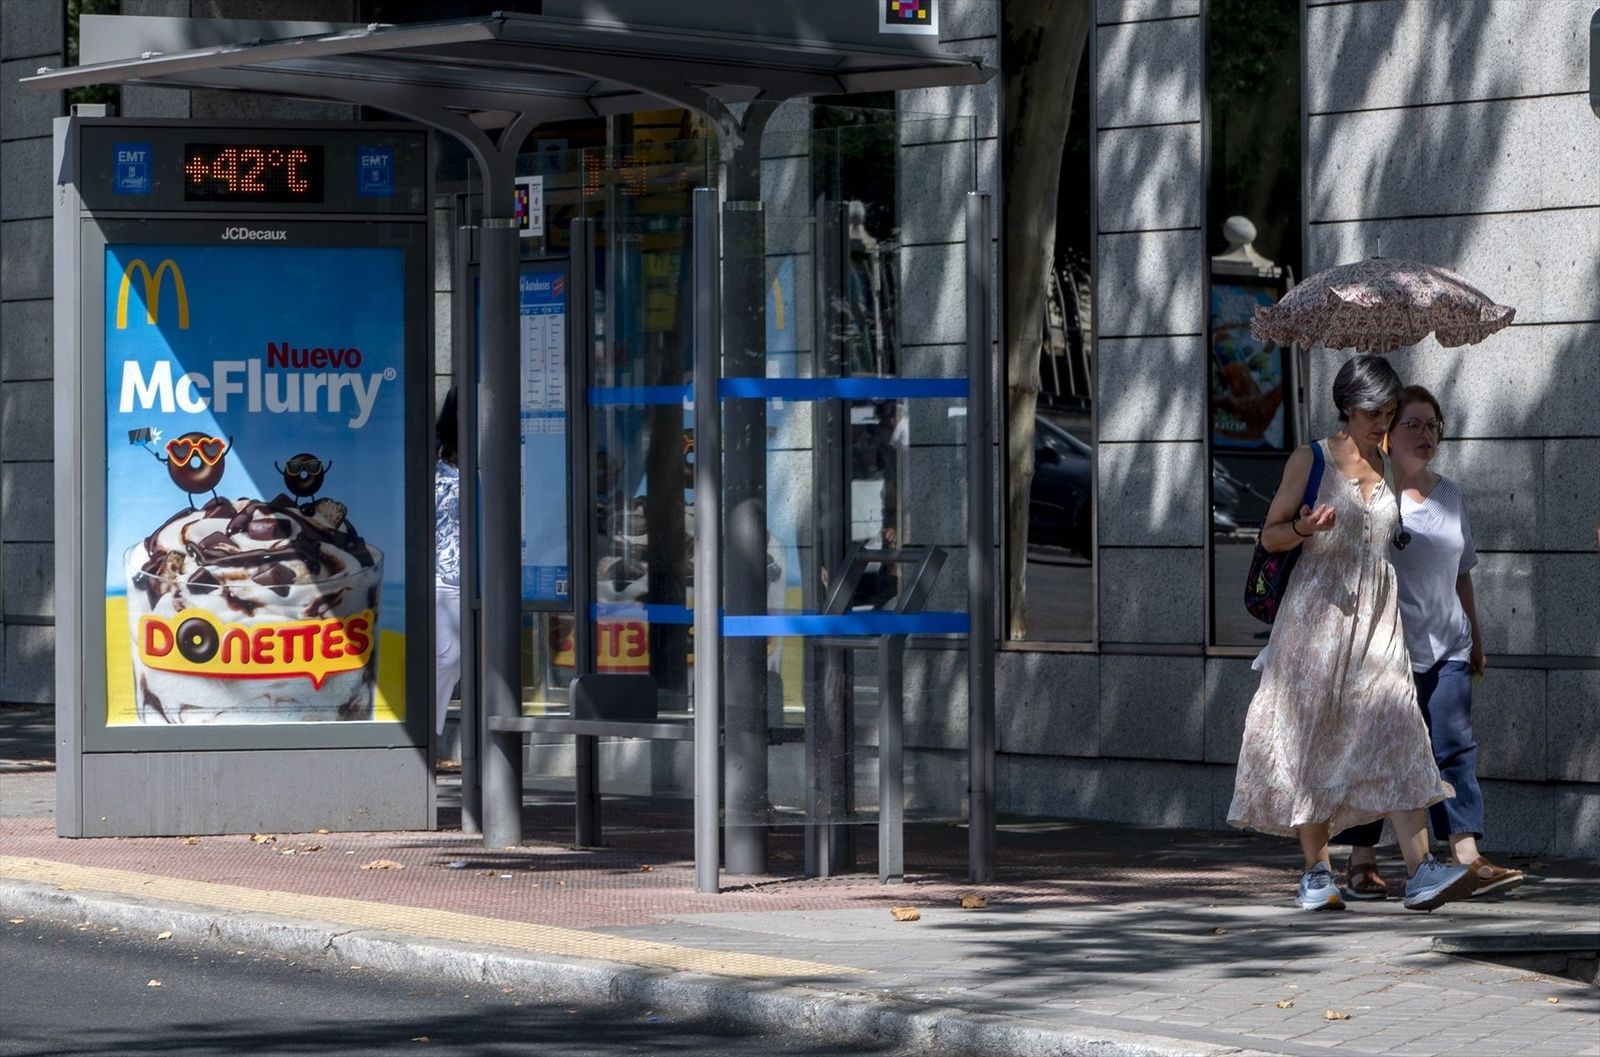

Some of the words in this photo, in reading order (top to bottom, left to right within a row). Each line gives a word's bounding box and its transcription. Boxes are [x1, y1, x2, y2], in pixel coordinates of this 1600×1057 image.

[118, 150, 146, 163] EMT
[361, 155, 389, 167] EMT
[185, 148, 308, 193] +42°C
[221, 227, 287, 241] JCDecaux
[267, 342, 362, 369] Nuevo
